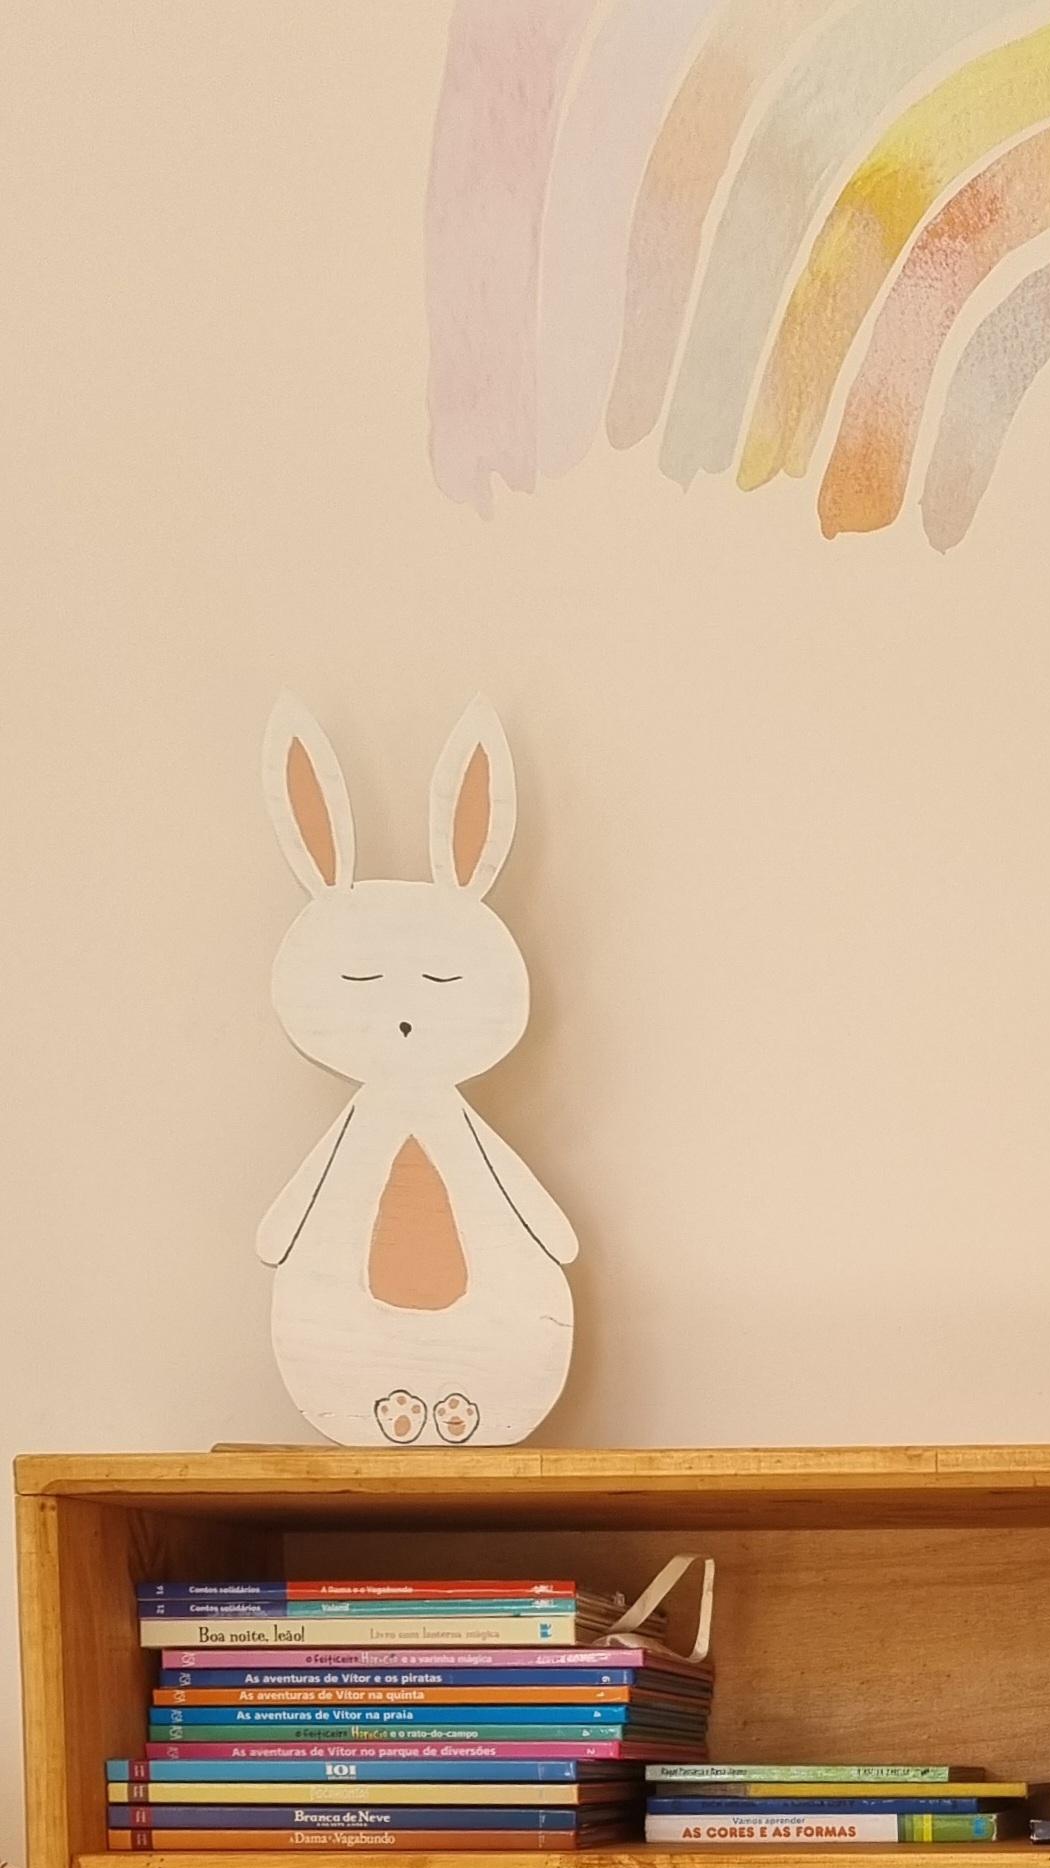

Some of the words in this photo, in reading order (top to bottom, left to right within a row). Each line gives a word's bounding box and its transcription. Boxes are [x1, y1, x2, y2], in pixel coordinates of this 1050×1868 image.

[199, 1626, 225, 1642] Boa
[230, 1630, 269, 1642] noite,
[274, 1624, 305, 1642] leão!
[245, 1674, 260, 1683] As
[263, 1674, 321, 1683] aventuras
[323, 1672, 339, 1683] de
[401, 1672, 442, 1685] piratas
[239, 1691, 254, 1700] As
[257, 1690, 315, 1700] aventuras
[317, 1689, 333, 1699] de
[368, 1691, 384, 1699] na
[386, 1689, 425, 1702] quinta
[236, 1710, 251, 1720] As
[254, 1710, 312, 1720] aventuras
[315, 1709, 330, 1720] de
[383, 1709, 414, 1721] praia
[389, 1730, 397, 1738] e
[398, 1730, 405, 1738] o
[407, 1728, 479, 1739] rato-do-campo
[232, 1747, 246, 1757] As
[249, 1747, 307, 1757] aventuras
[310, 1746, 325, 1756] de
[360, 1748, 376, 1756] no
[378, 1748, 420, 1758] parque
[422, 1745, 437, 1756] de
[440, 1745, 497, 1756] diversões
[294, 1809, 341, 1822] Branca
[342, 1812, 358, 1822] de
[358, 1809, 391, 1823] Neve
[732, 1817, 762, 1825] Vamos
[765, 1816, 806, 1827] aprender
[682, 1827, 702, 1839] AS
[706, 1826, 755, 1838] CORES
[760, 1826, 768, 1838] E
[772, 1826, 791, 1838] AS
[796, 1825, 857, 1838] FORMAS
[294, 1832, 328, 1844] Dama
[334, 1832, 396, 1847] Vagabundo
